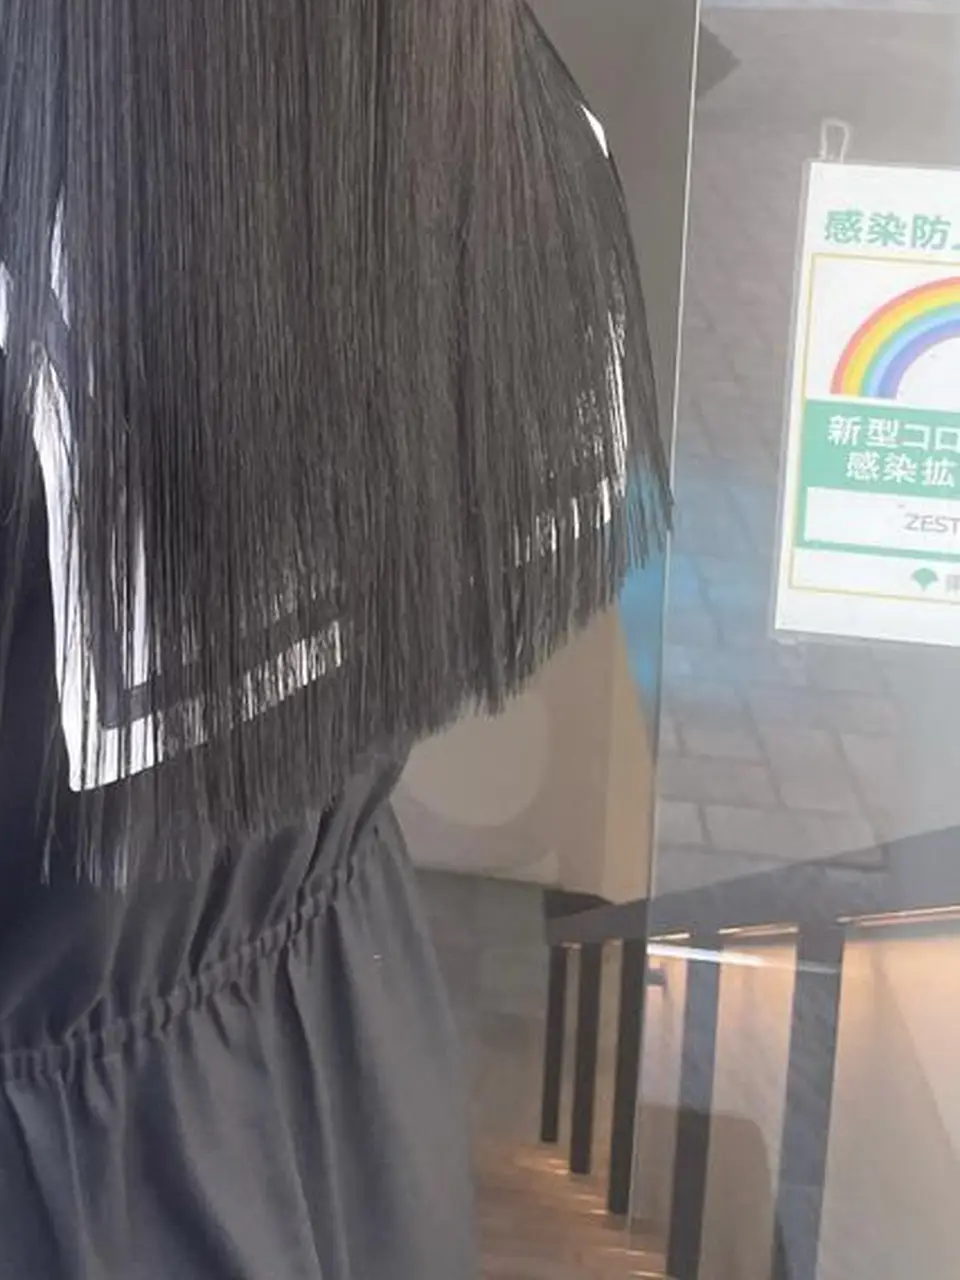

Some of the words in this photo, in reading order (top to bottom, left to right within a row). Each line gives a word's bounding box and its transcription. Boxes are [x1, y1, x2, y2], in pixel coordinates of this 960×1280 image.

[824, 209, 960, 251] 感染防
[903, 512, 960, 536] ZEST
